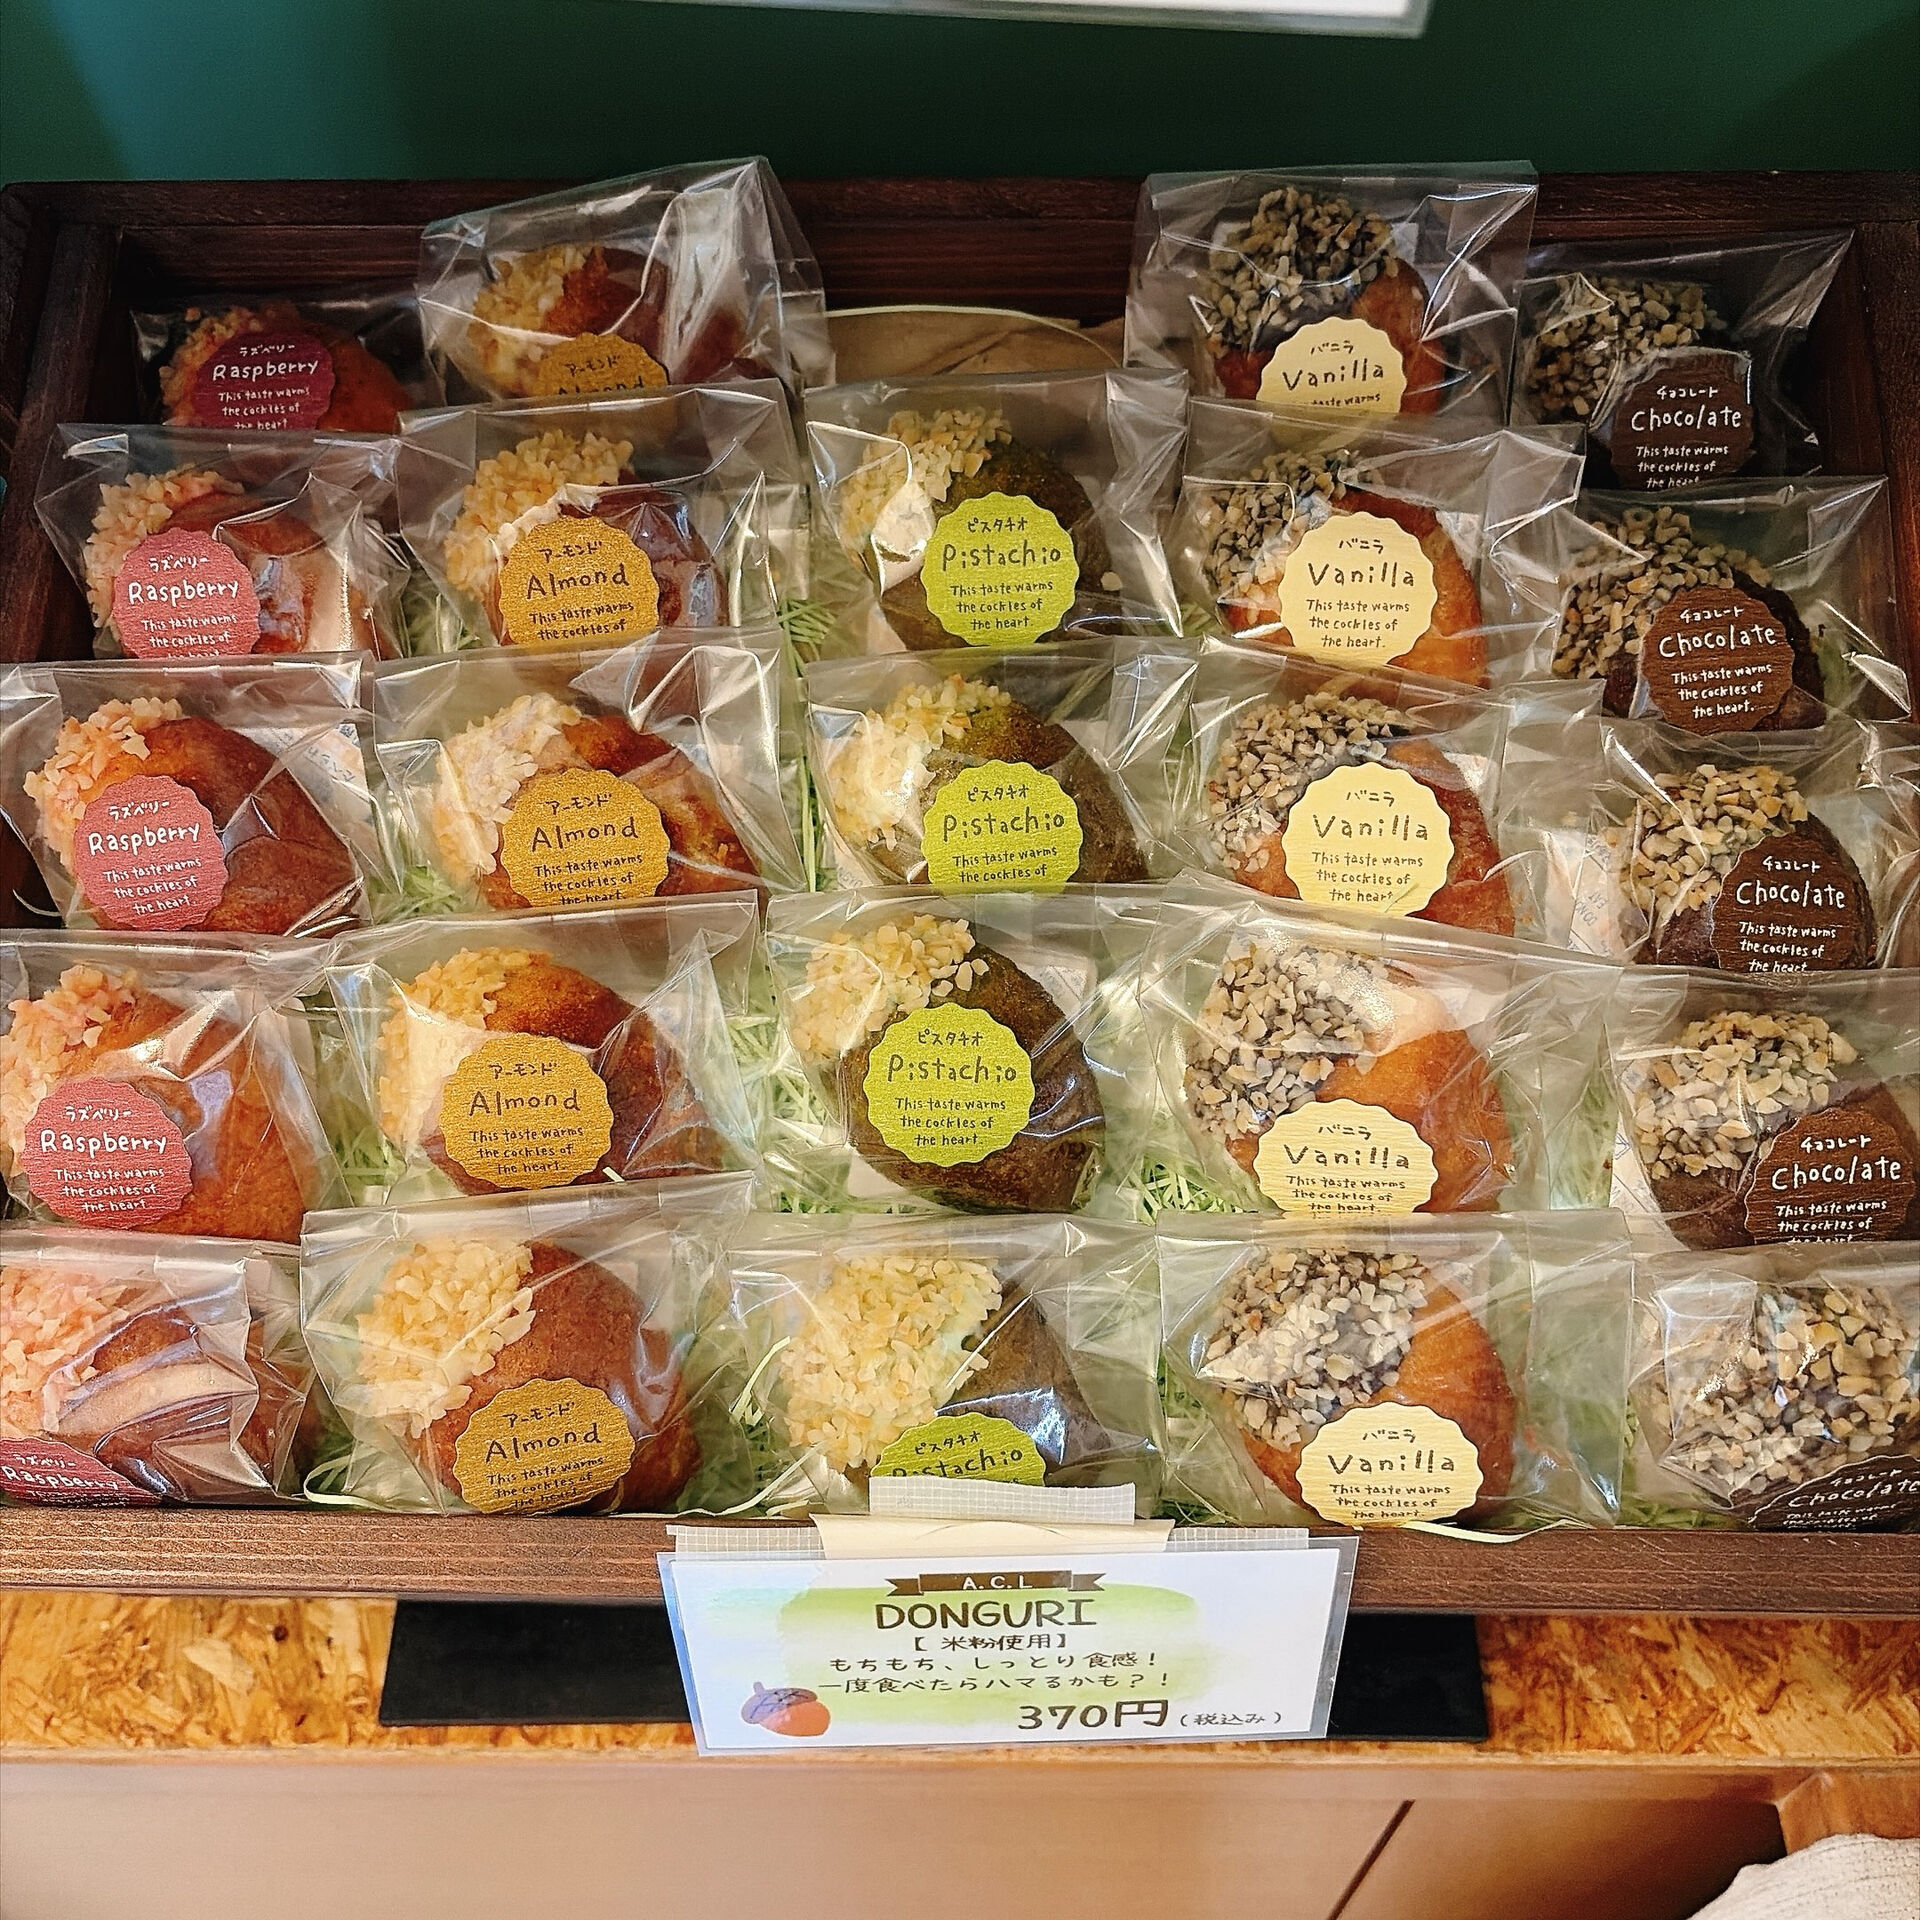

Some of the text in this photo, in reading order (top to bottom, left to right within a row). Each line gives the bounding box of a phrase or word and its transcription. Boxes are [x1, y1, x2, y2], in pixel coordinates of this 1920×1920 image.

[240, 344, 295, 357] ラズベリー
[1310, 340, 1354, 355] バニラ
[212, 360, 319, 382] Raspberry
[1282, 358, 1383, 390] Vanilla
[1344, 394, 1380, 405] warms
[1657, 386, 1718, 400] チョコレート
[1632, 405, 1742, 431] Chocolate
[968, 517, 1028, 532] ピスタチオ
[539, 541, 602, 563] アーモンド
[1339, 538, 1383, 554] バニラ
[149, 555, 210, 572] ラズベリー
[942, 539, 1061, 572] Pistachio
[527, 563, 629, 599] Almond
[1308, 562, 1414, 587] Vanilla
[128, 579, 239, 607] Raspberry
[950, 581, 1053, 597] This taste warms
[529, 602, 634, 625] This taste warms
[956, 598, 1043, 613] the cockles of
[1307, 599, 1410, 612] This taste warms
[1680, 606, 1745, 623] チョコレート
[970, 619, 991, 630] the
[1309, 617, 1398, 631] the cockles of
[1321, 635, 1341, 648] the
[1659, 624, 1776, 658] Chocolate
[1671, 664, 1772, 685] This taste warms
[1678, 681, 1763, 700] the cockles of
[1692, 706, 1712, 719] the
[968, 784, 1029, 802] ピスタチオ
[1346, 790, 1395, 807] バニラ
[109, 800, 170, 820] ラズベリー
[546, 793, 612, 815] アーモンド
[943, 806, 1065, 842] Pistachio
[1313, 814, 1428, 841] Vanilla
[88, 823, 199, 856] Raspberry
[531, 817, 638, 852] Almond
[534, 854, 643, 878] This taste warms
[952, 846, 1057, 868] This taste warms
[1312, 852, 1423, 867] This taste warms
[1762, 856, 1820, 873] チョコレート
[103, 858, 201, 883] This taste warms
[959, 864, 1048, 883] the cockles of
[1316, 869, 1411, 885] the cockles of
[113, 875, 198, 899] the cockles of
[542, 872, 633, 892] the cockles of
[1329, 889, 1351, 901] the
[1736, 880, 1845, 908] Chocolate
[133, 904, 154, 915] the
[1739, 921, 1836, 938] This taste warms
[1740, 939, 1825, 957] the cockles of
[1749, 960, 1768, 972] the
[918, 1028, 983, 1046] ピスタチオ
[489, 1062, 558, 1079] アーモンド
[888, 1054, 1017, 1083] Pistachio
[468, 1089, 581, 1116] Almond
[895, 1098, 1006, 1110] This taste warms
[63, 1105, 132, 1122] ラズベリー
[900, 1116, 994, 1128] the cockles of
[469, 1128, 583, 1142] This taste warms
[914, 1135, 936, 1146] the
[1318, 1125, 1372, 1140] バニラ
[40, 1130, 167, 1158] Raspberry
[478, 1144, 574, 1159] the cockles of
[1800, 1135, 1872, 1153] チョコレート
[1283, 1144, 1409, 1169] Vanilla
[53, 1168, 164, 1182] This taste warms
[497, 1163, 517, 1174] the
[1772, 1156, 1901, 1190] Chocolate
[62, 1184, 157, 1197] the cockles of
[82, 1202, 105, 1212] the
[1776, 1200, 1887, 1217] This taste warms
[1778, 1217, 1872, 1232] the cockles of
[502, 1402, 575, 1428] アーモンド
[485, 1422, 601, 1463] Almond
[915, 1431, 980, 1455] ピスタチオ
[1362, 1429, 1416, 1443] バニラ
[892, 1449, 1023, 1477] Pstachio
[1328, 1450, 1454, 1474] Vanilla
[0, 1465, 119, 1490] Raspberry
[961, 1574, 1034, 1591] A.C.L
[875, 1599, 1097, 1630] DONGURI
[1018, 1700, 1168, 1730] 370円
